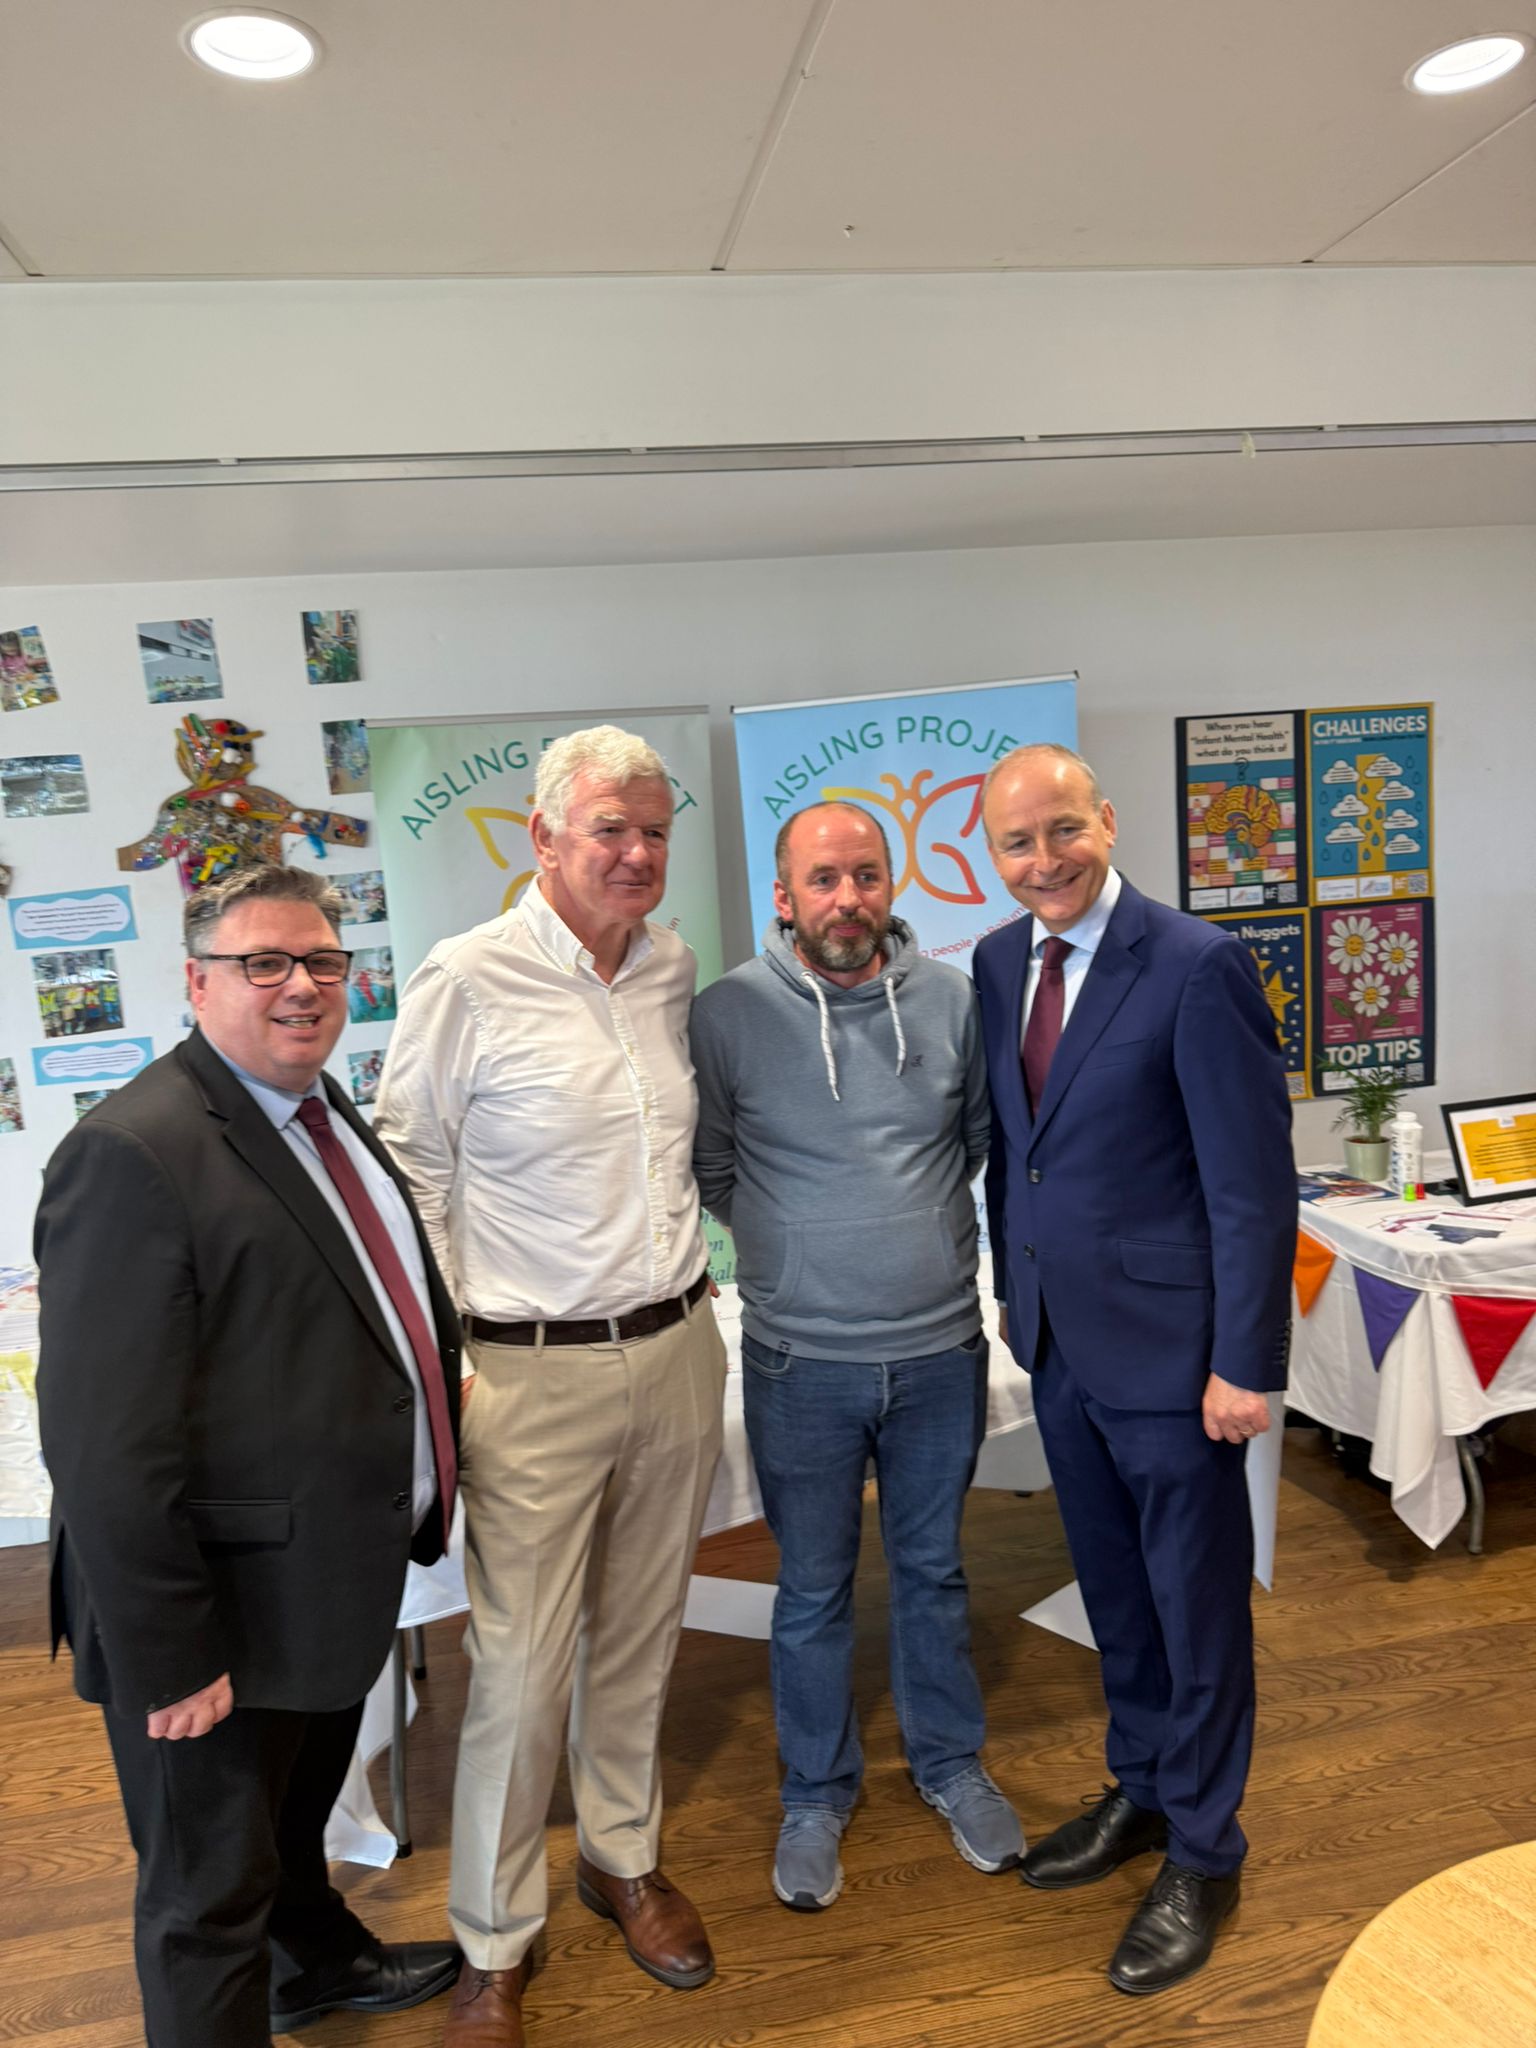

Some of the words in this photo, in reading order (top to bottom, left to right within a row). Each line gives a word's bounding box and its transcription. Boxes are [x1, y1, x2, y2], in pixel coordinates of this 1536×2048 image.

[1206, 721, 1232, 731] When
[1234, 723, 1251, 731] you
[1253, 720, 1274, 729] hear
[1312, 715, 1427, 738] CHALLENGES
[1224, 734, 1254, 743] Mental
[1196, 748, 1220, 757] what
[1221, 747, 1233, 756] do
[1235, 748, 1251, 757] you
[1253, 745, 1275, 754] think
[1277, 743, 1288, 752] of
[762, 721, 884, 819] AISLING
[897, 715, 1020, 762] PROJE
[401, 741, 529, 840] AISLING
[1240, 924, 1302, 941] Nuggets
[931, 939, 973, 959] people
[1324, 1044, 1372, 1067] TOP
[1374, 1038, 1423, 1063] TIPS
